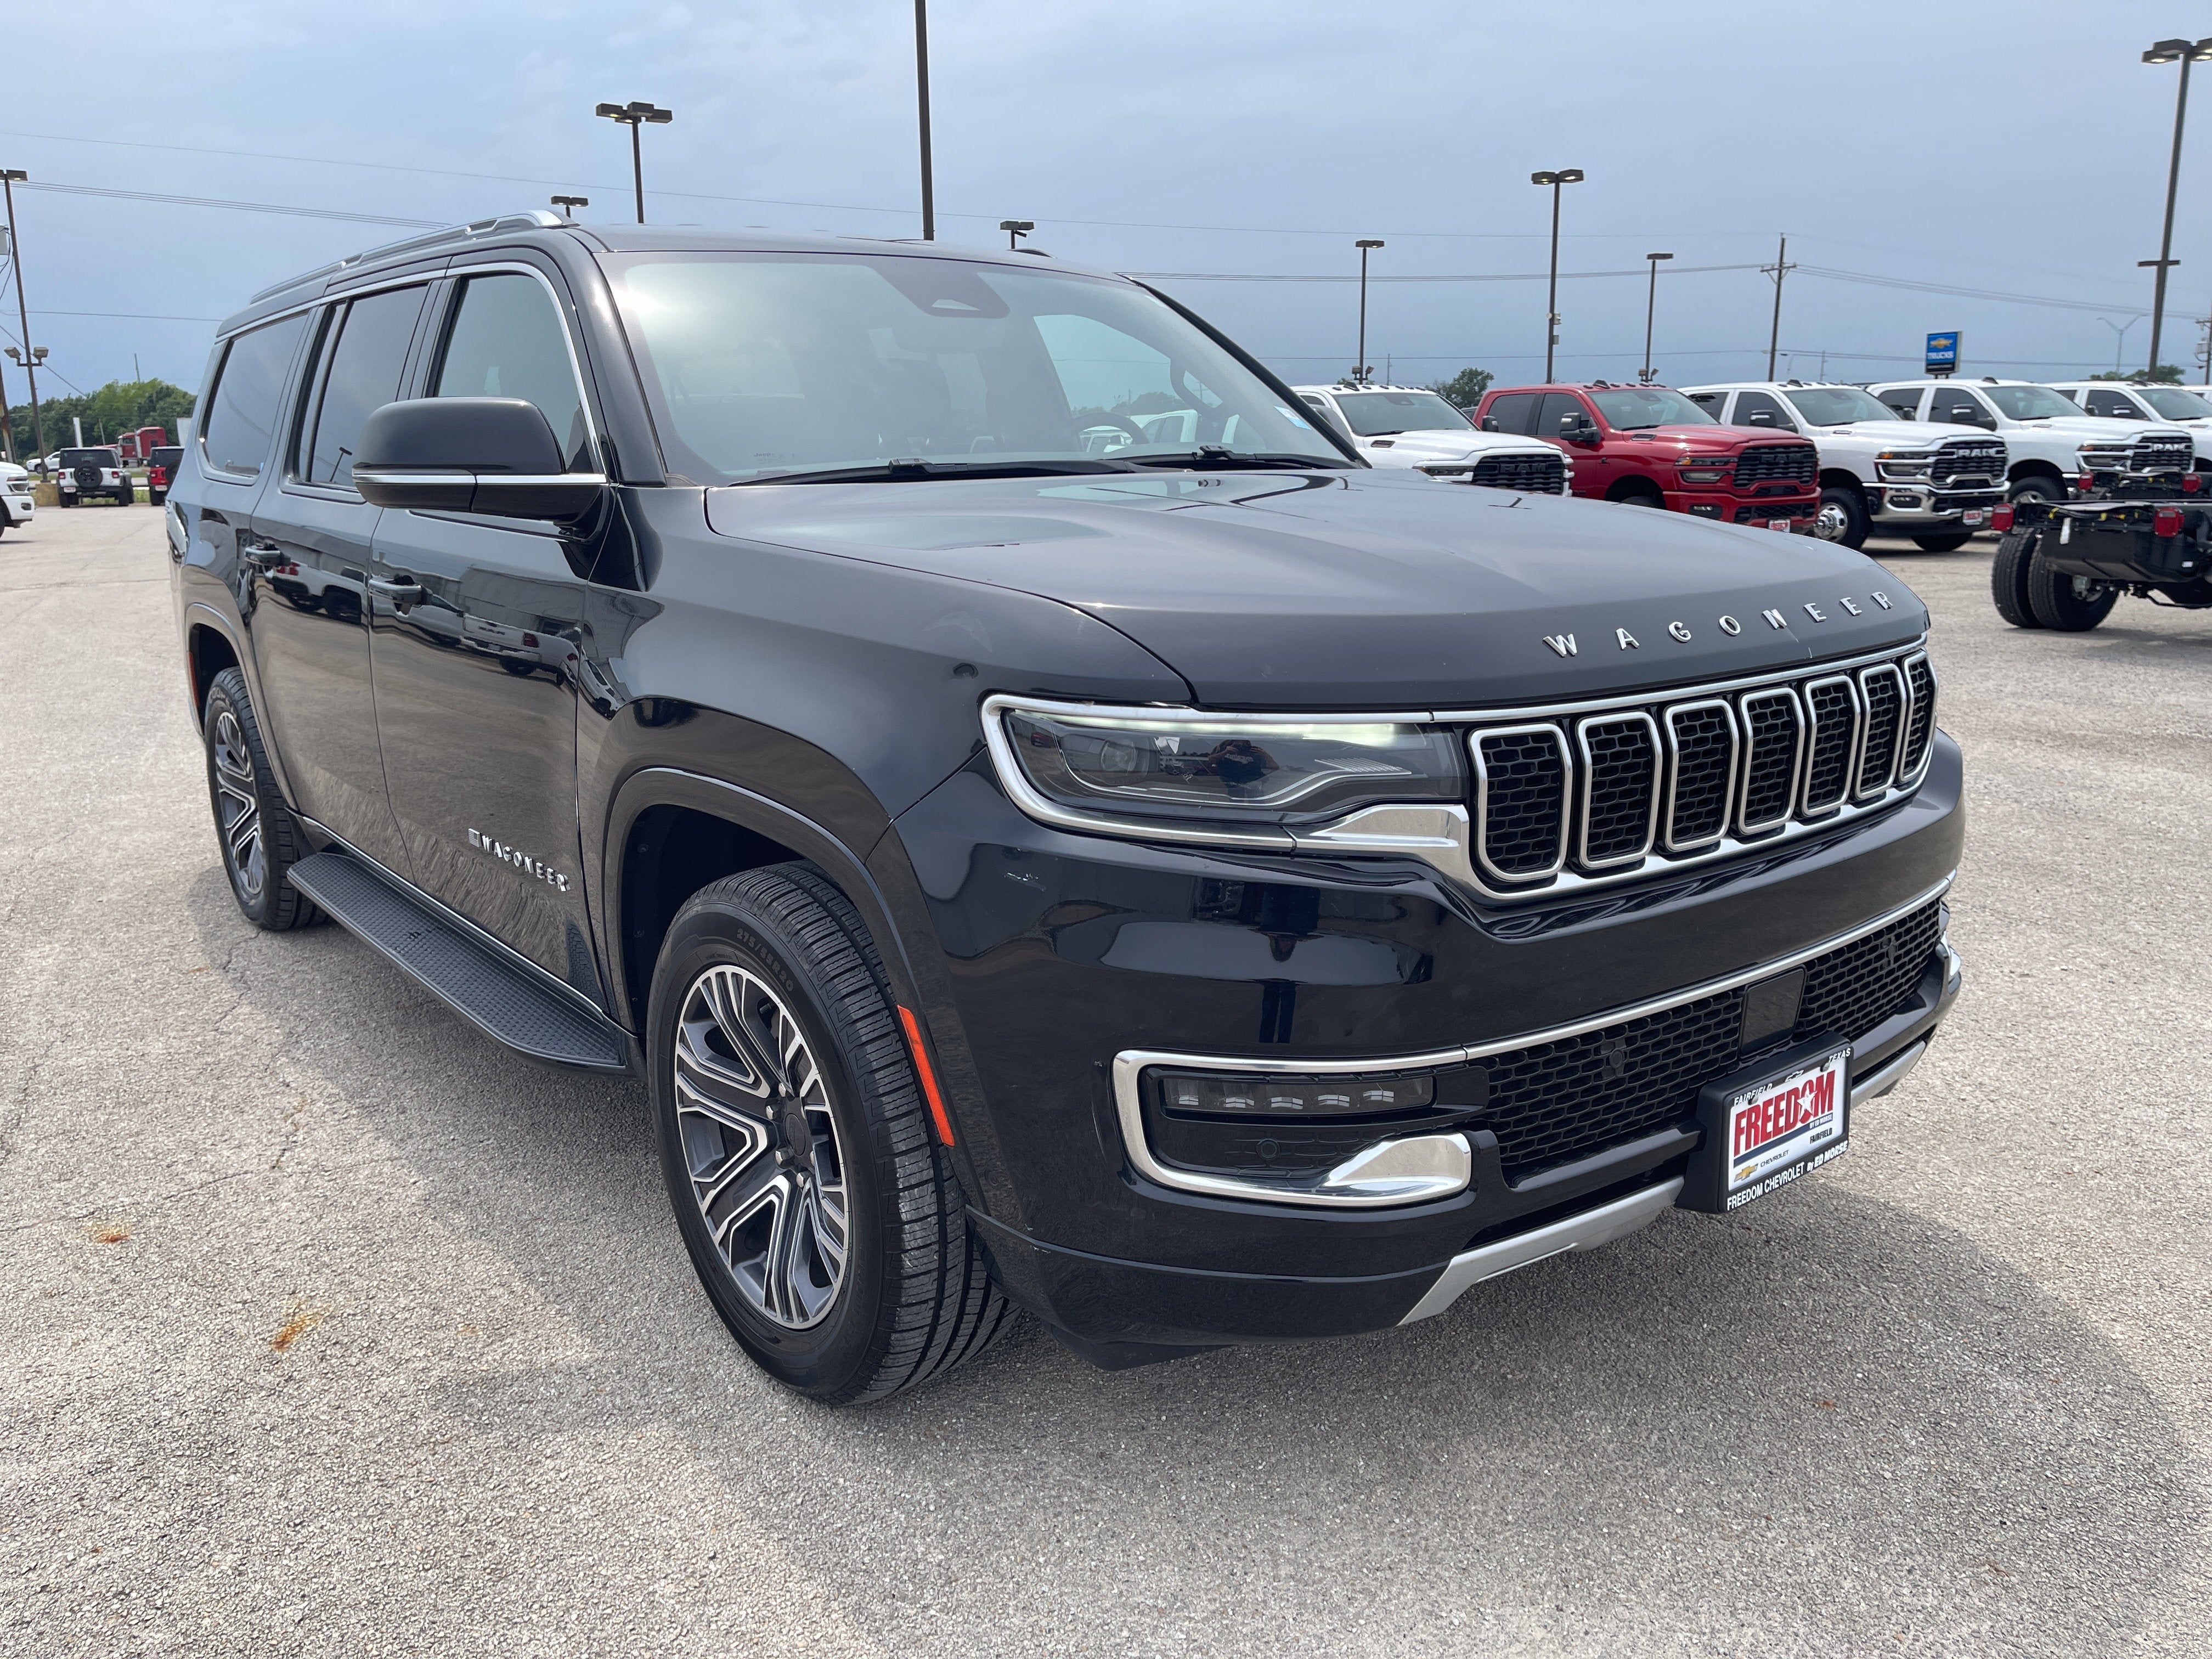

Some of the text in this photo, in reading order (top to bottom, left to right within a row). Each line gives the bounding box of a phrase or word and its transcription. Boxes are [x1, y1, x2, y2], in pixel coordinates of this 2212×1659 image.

[1958, 448, 1995, 458] RAM
[1500, 463, 1546, 473] RAM
[1542, 591, 1893, 658] WAGONEER
[482, 835, 571, 892] WAGONEER
[1829, 1047, 1851, 1063] TEXAS
[1734, 1082, 1773, 1106] FAIRFIELD
[1734, 1070, 1836, 1157] FREEDOM
[1810, 1127, 1832, 1144] FAIRFIELD
[1760, 1149, 1790, 1167] CHEVROLET
[1727, 1182, 1763, 1211] FREEDOM
[1764, 1161, 1805, 1193] CHEVROLET
[1814, 1153, 1824, 1167] ED
[1824, 1140, 1848, 1163] MORSE
